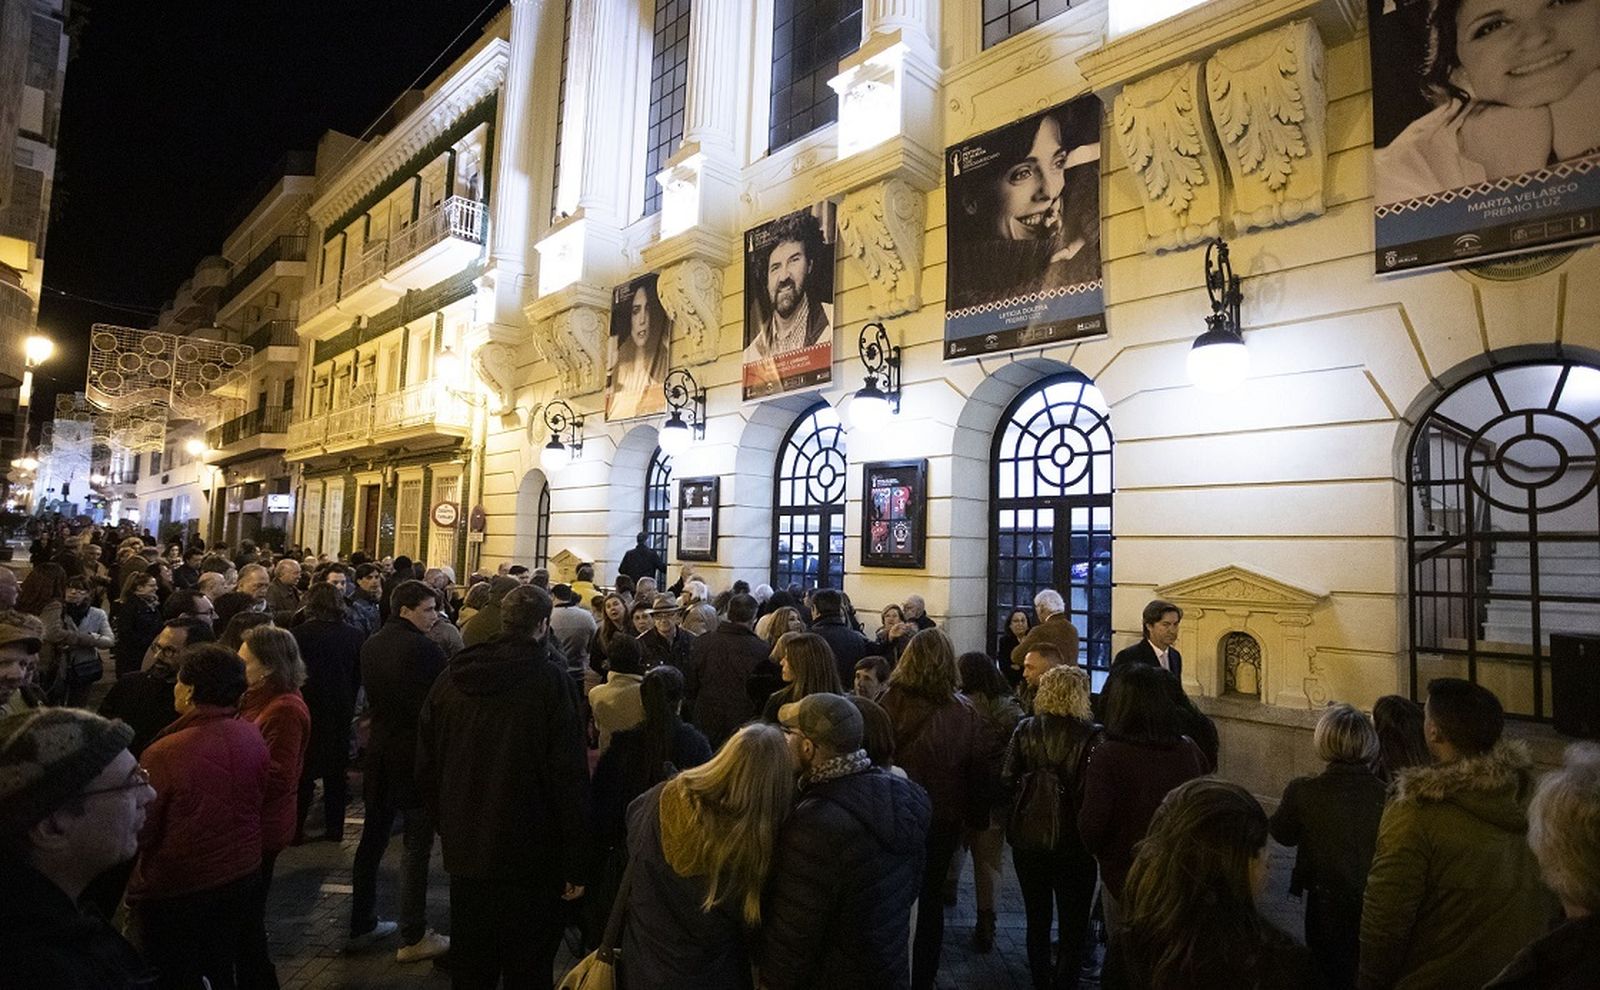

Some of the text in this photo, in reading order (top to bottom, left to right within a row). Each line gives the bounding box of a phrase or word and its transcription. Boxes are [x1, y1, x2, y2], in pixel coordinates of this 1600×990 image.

[1467, 183, 1579, 213] MARTA VELASCO
[1483, 197, 1562, 219] PREMIO LUZ
